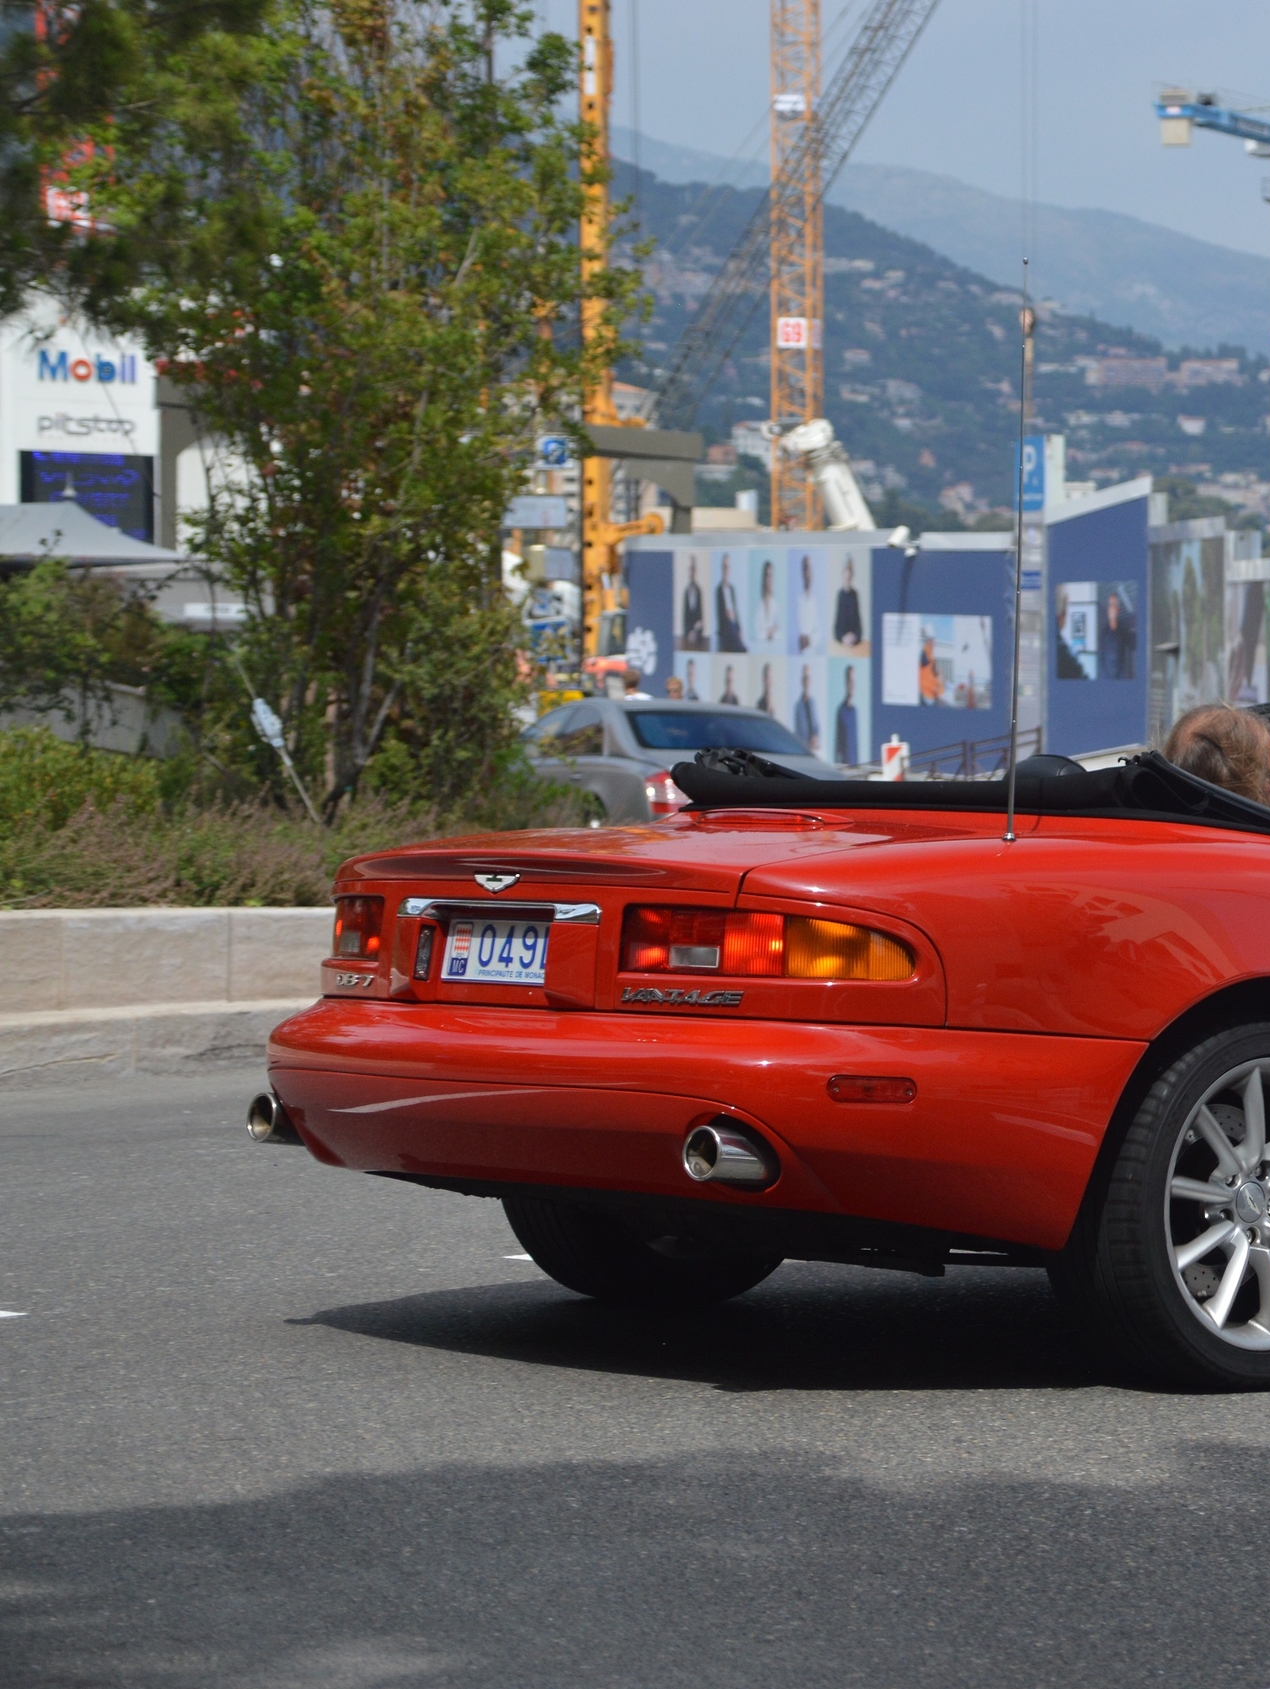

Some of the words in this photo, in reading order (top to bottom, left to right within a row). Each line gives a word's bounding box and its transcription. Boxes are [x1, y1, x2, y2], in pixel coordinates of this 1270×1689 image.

[38, 349, 137, 383] Mobil
[37, 412, 136, 437] pitstop
[452, 959, 465, 973] MC
[478, 969, 513, 978] PRINCIPAUTE
[515, 971, 523, 979] DE
[336, 973, 375, 987] DB7
[621, 987, 744, 1005] VANTAGE
